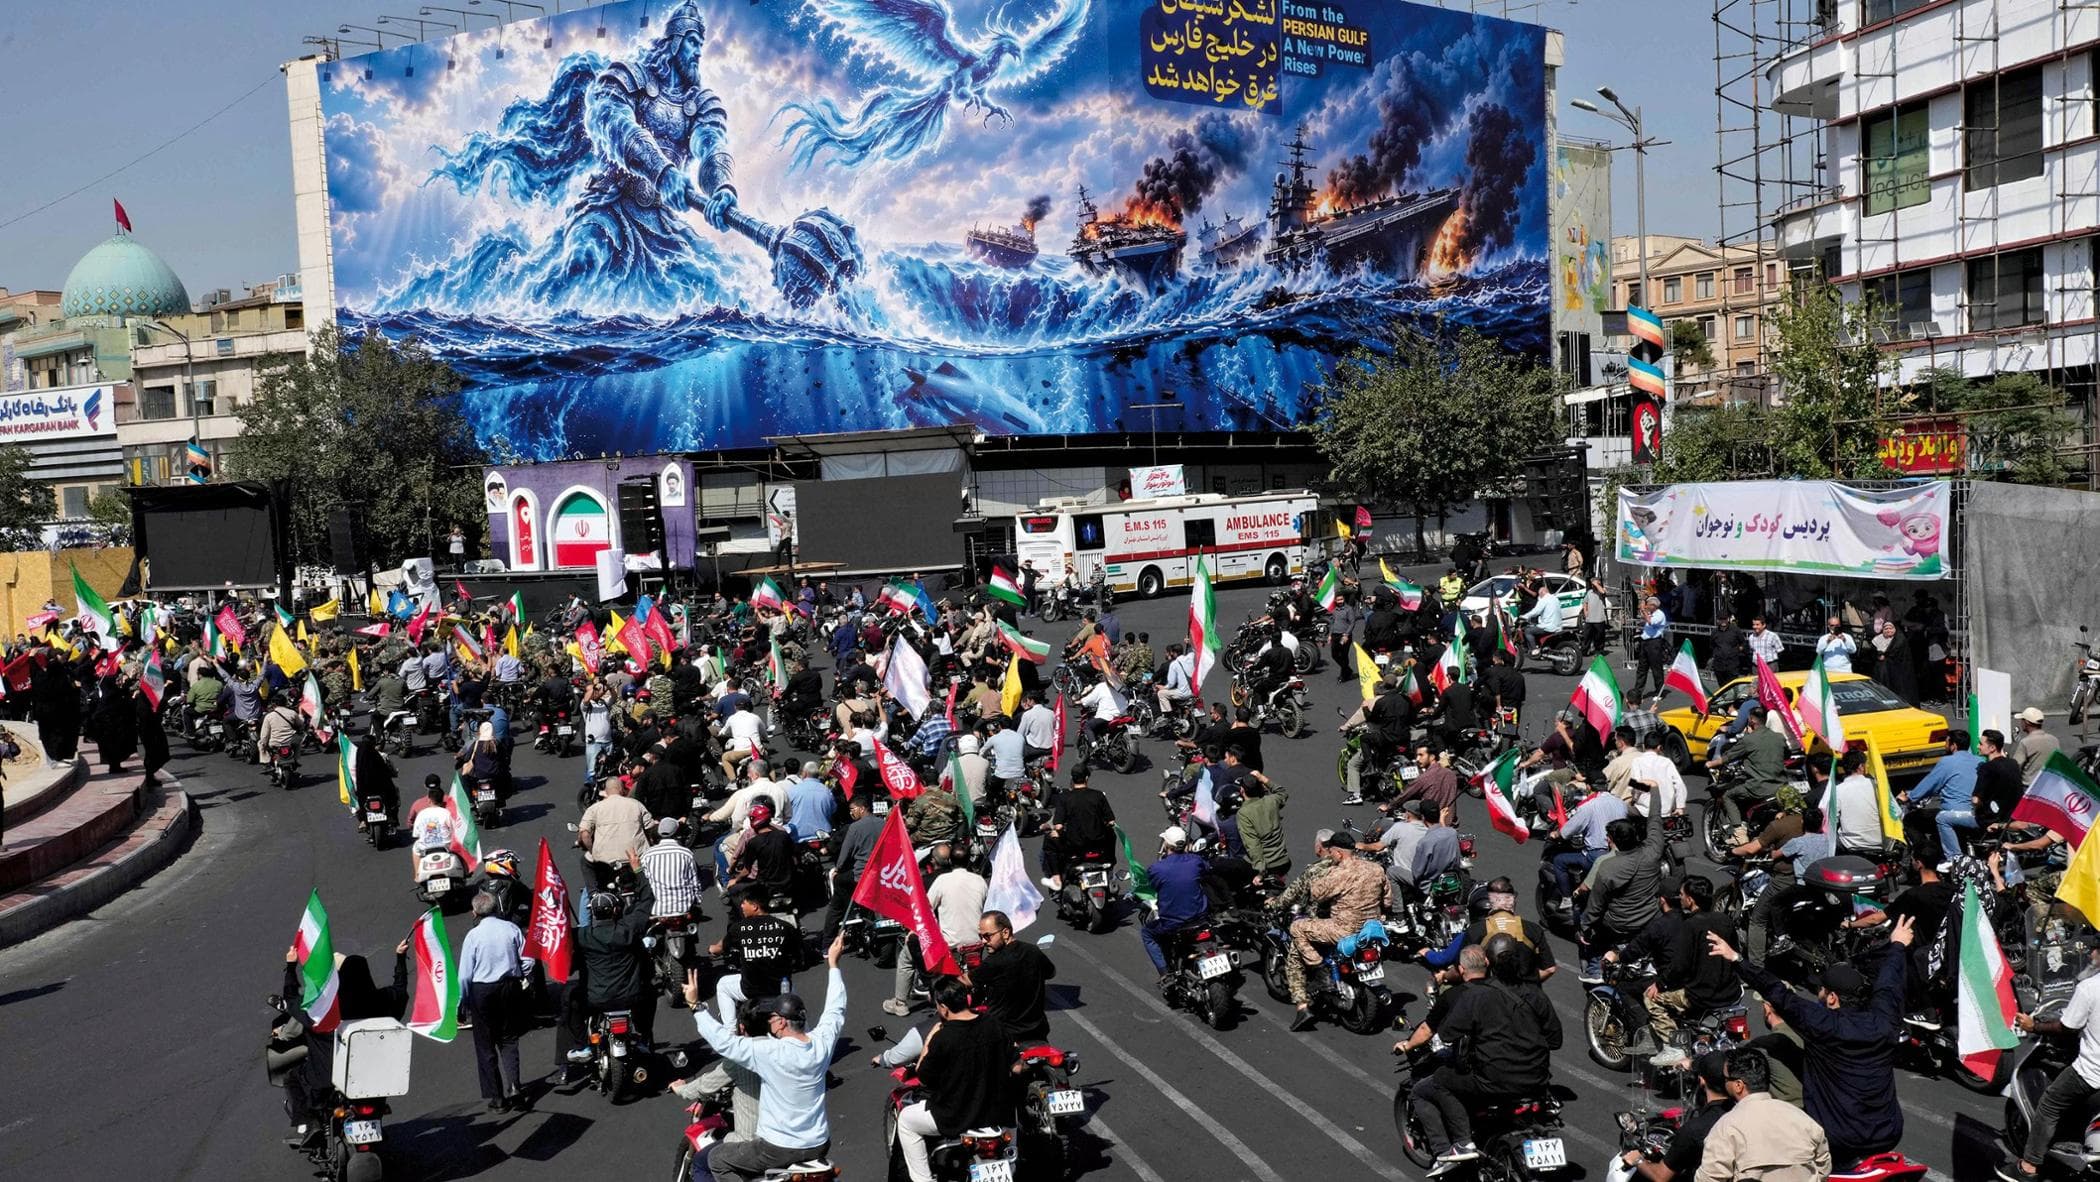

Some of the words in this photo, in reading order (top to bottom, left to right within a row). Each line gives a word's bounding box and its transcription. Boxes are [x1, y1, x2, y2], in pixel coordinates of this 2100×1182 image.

[1282, 0, 1317, 19] From
[1322, 7, 1344, 24] the
[1151, 19, 1202, 55] فارس
[1283, 18, 1335, 41] PERSIAN
[1338, 28, 1368, 46] GULF
[1205, 27, 1255, 62] خلیج
[1256, 41, 1277, 68] در
[1284, 37, 1294, 53] A
[1297, 39, 1324, 58] New
[1328, 44, 1366, 65] Power
[1147, 62, 1179, 88] شد
[1284, 56, 1317, 75] Rises
[1181, 65, 1240, 102] خواهد
[1243, 75, 1278, 109] غرق
[1875, 169, 1930, 200] POLICE
[23, 397, 49, 418] رفاه
[49, 395, 78, 417] بانک
[1125, 521, 1150, 532] E.M.S
[1153, 520, 1167, 530] 115
[1226, 512, 1290, 531] AMBULANCE
[1696, 513, 1733, 538] نوجوان
[1735, 520, 1743, 538] و
[1745, 513, 1782, 539] کودک
[1783, 518, 1830, 541] پردیس
[1238, 532, 1259, 540] EMS
[1264, 530, 1280, 538] 115
[760, 922, 784, 931] risk,
[757, 936, 785, 945] story
[744, 945, 782, 961] lucky.
